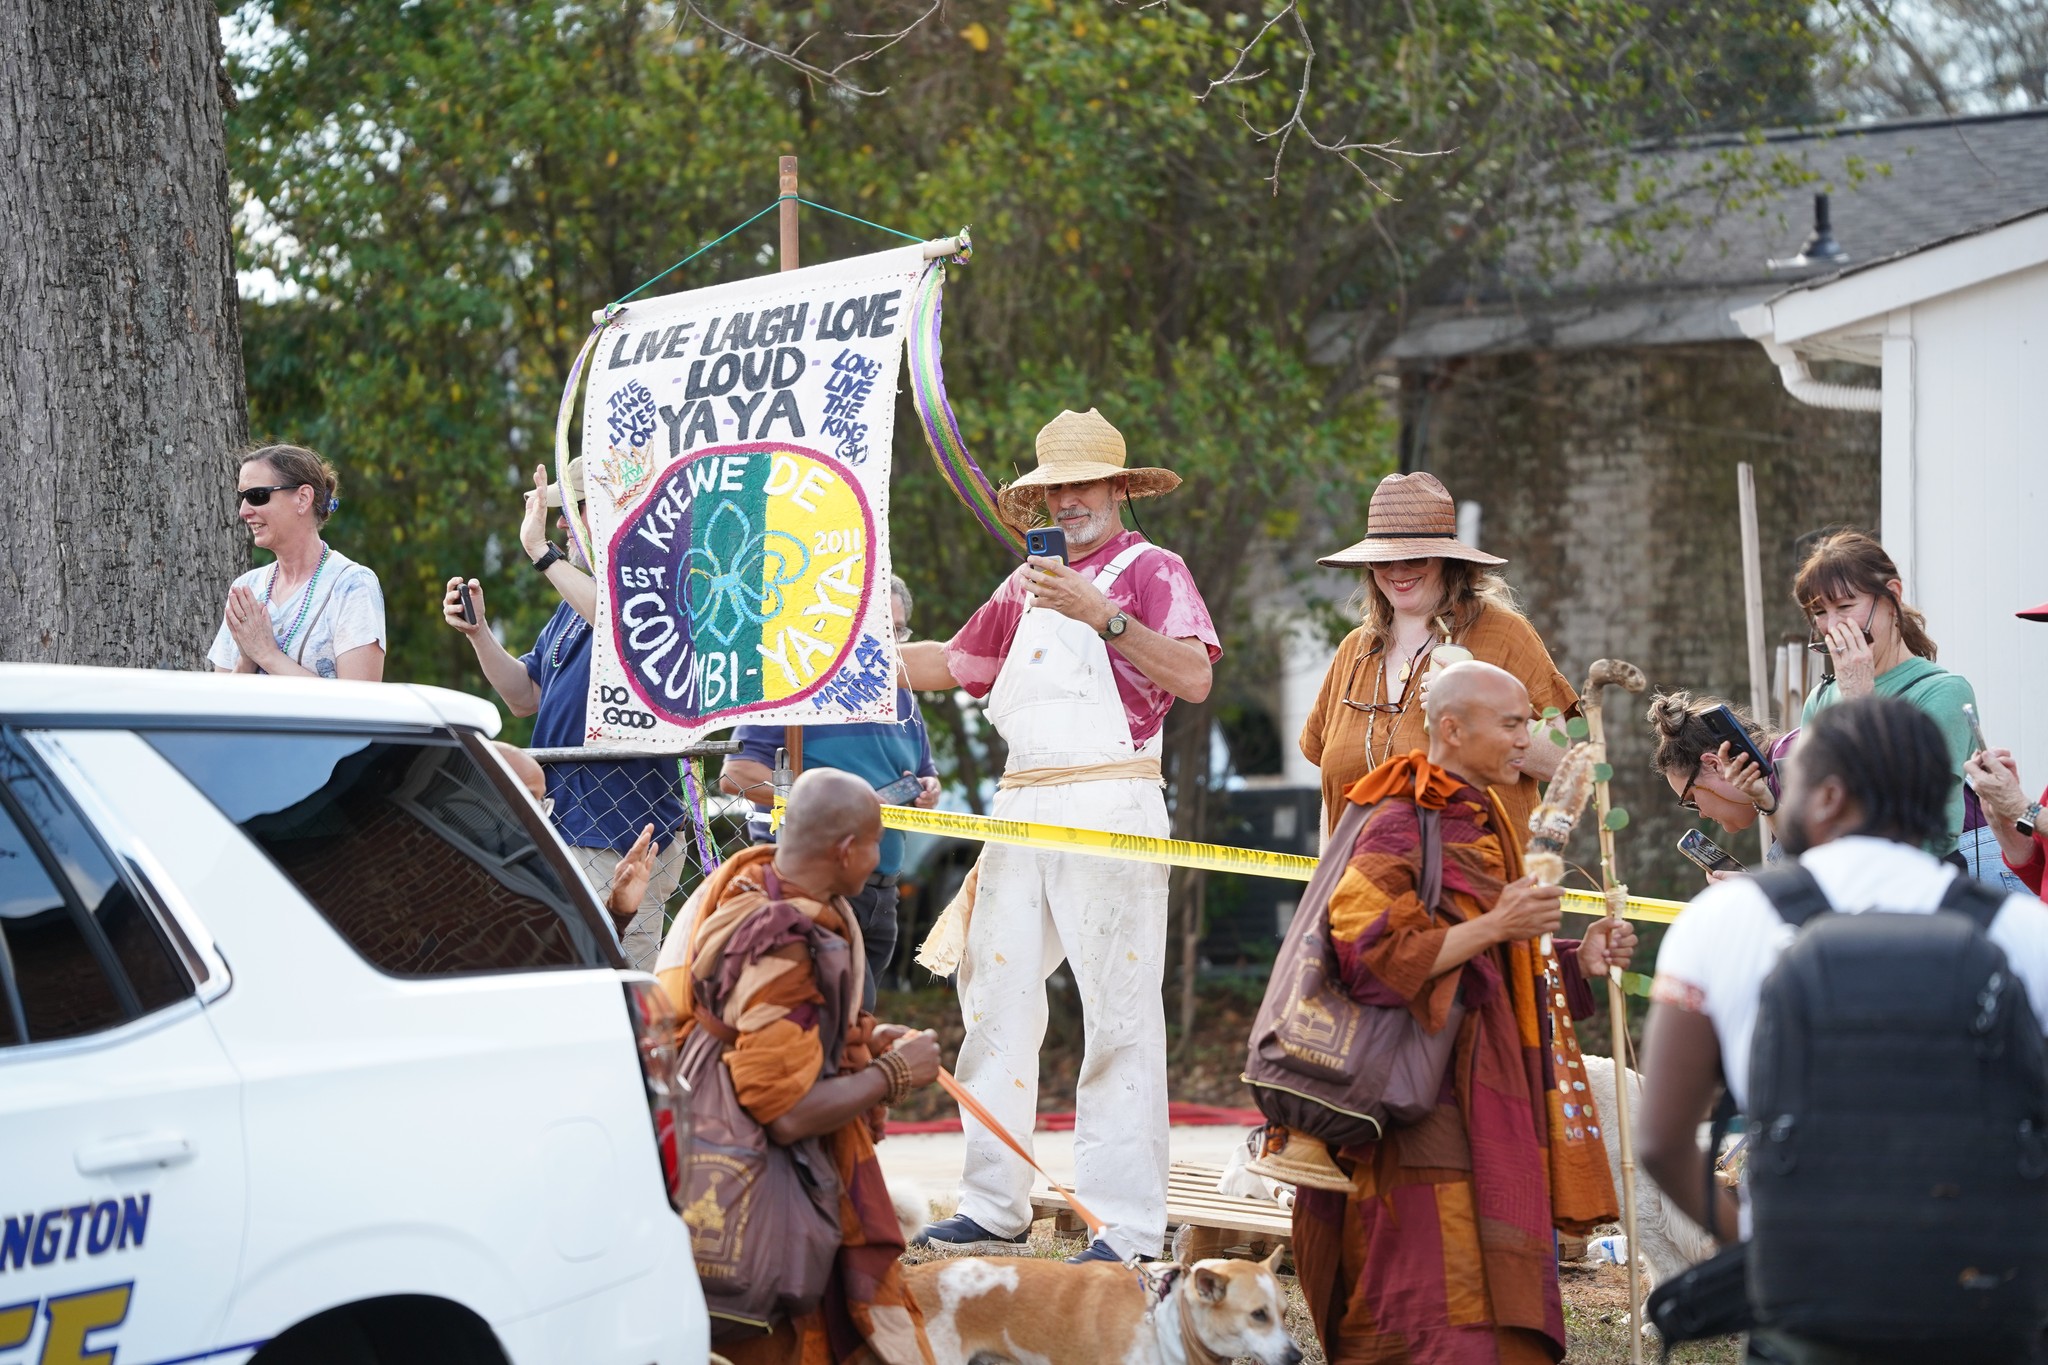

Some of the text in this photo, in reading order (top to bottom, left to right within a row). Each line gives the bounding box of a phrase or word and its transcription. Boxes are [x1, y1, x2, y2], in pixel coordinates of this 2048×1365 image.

[608, 289, 902, 370] LIVE LAUGH LOVE
[685, 347, 806, 401] LOUD
[831, 348, 879, 380] LONG
[606, 379, 641, 410] THE
[824, 370, 875, 402] LIVE
[607, 387, 652, 430] KING
[822, 393, 865, 420] THE
[609, 400, 656, 446] LIVES
[630, 419, 657, 447] ON
[820, 415, 868, 444] KING
[638, 454, 834, 553] KREWE DE
[620, 527, 862, 591] EST. 2011
[811, 633, 880, 710] MAKE AN
[600, 686, 630, 705] DO
[603, 707, 657, 729] GOOD
